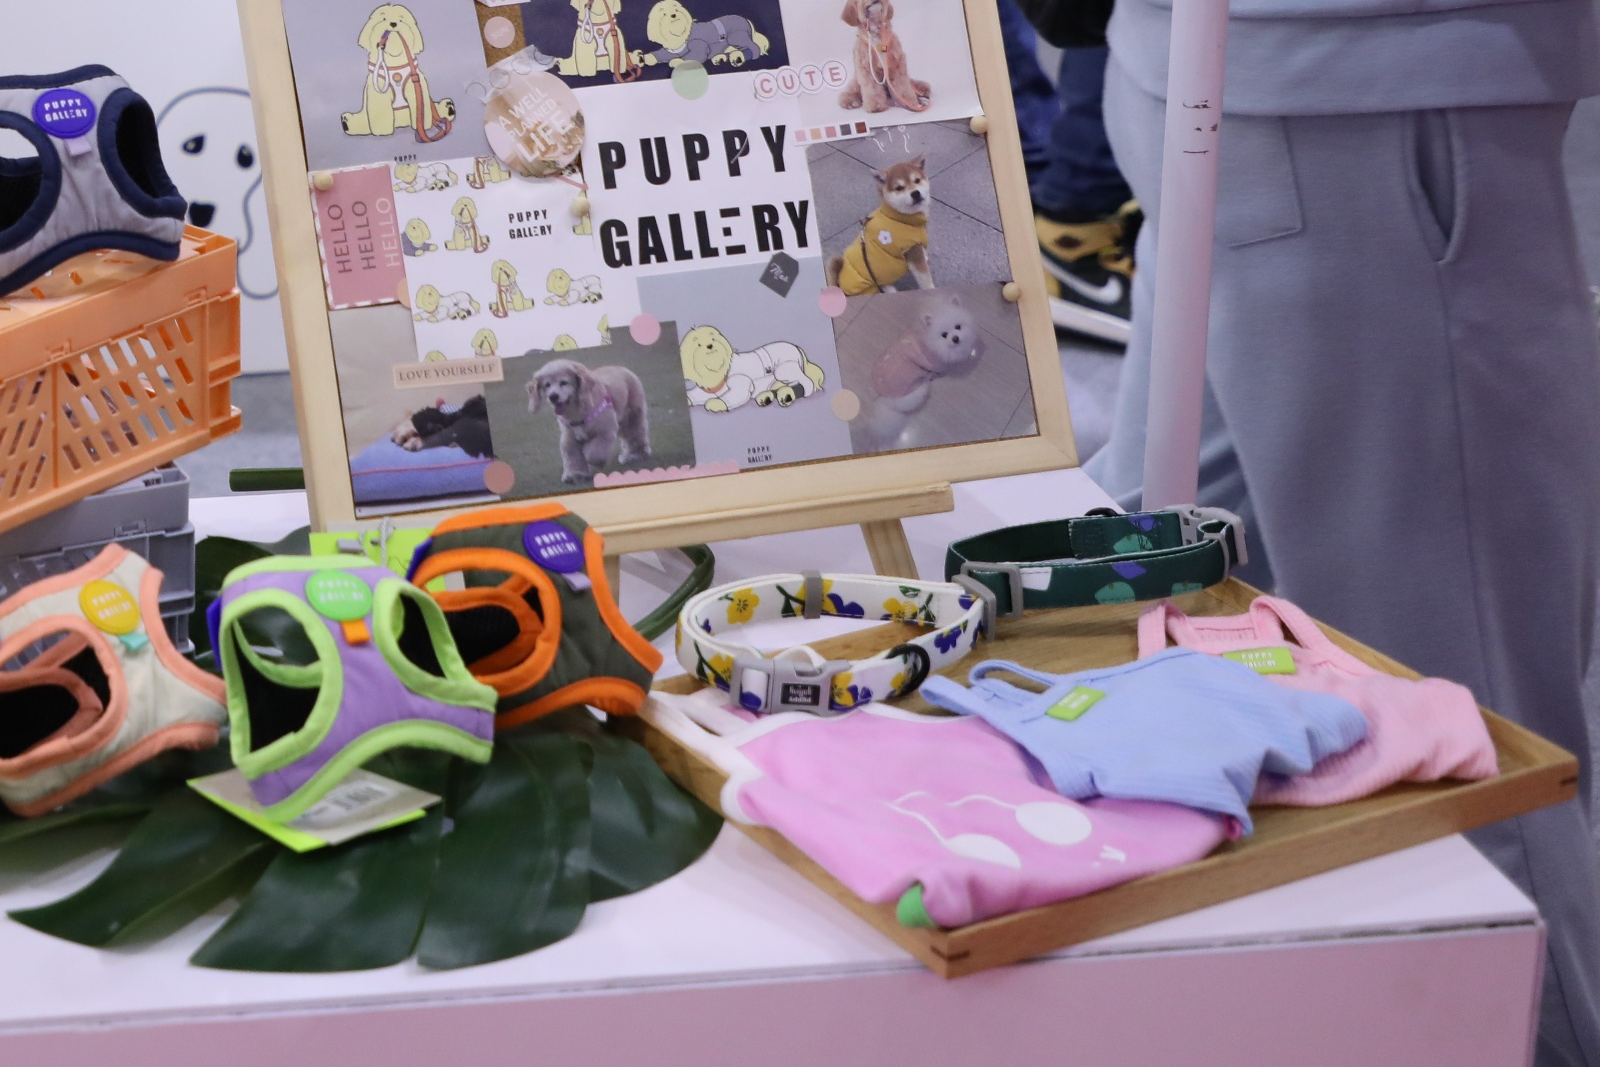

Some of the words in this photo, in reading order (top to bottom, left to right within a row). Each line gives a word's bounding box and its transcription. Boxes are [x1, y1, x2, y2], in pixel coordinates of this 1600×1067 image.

[760, 66, 842, 94] CUTE
[44, 98, 82, 112] PUPPY
[44, 108, 88, 123] GALLERY
[498, 115, 509, 129] A
[508, 87, 548, 116] WELL
[509, 97, 557, 142] PLANNED
[516, 110, 570, 163] LIFE
[598, 124, 786, 190] PUPPY
[351, 201, 377, 271] HELLO
[375, 197, 401, 268] HELLO
[508, 209, 548, 224] PUPPY
[509, 224, 553, 240] GALLERY
[599, 199, 809, 269] GALLERY
[327, 204, 353, 274] HELLO
[399, 369, 432, 382] LOVE
[433, 363, 495, 378] YOURSELF
